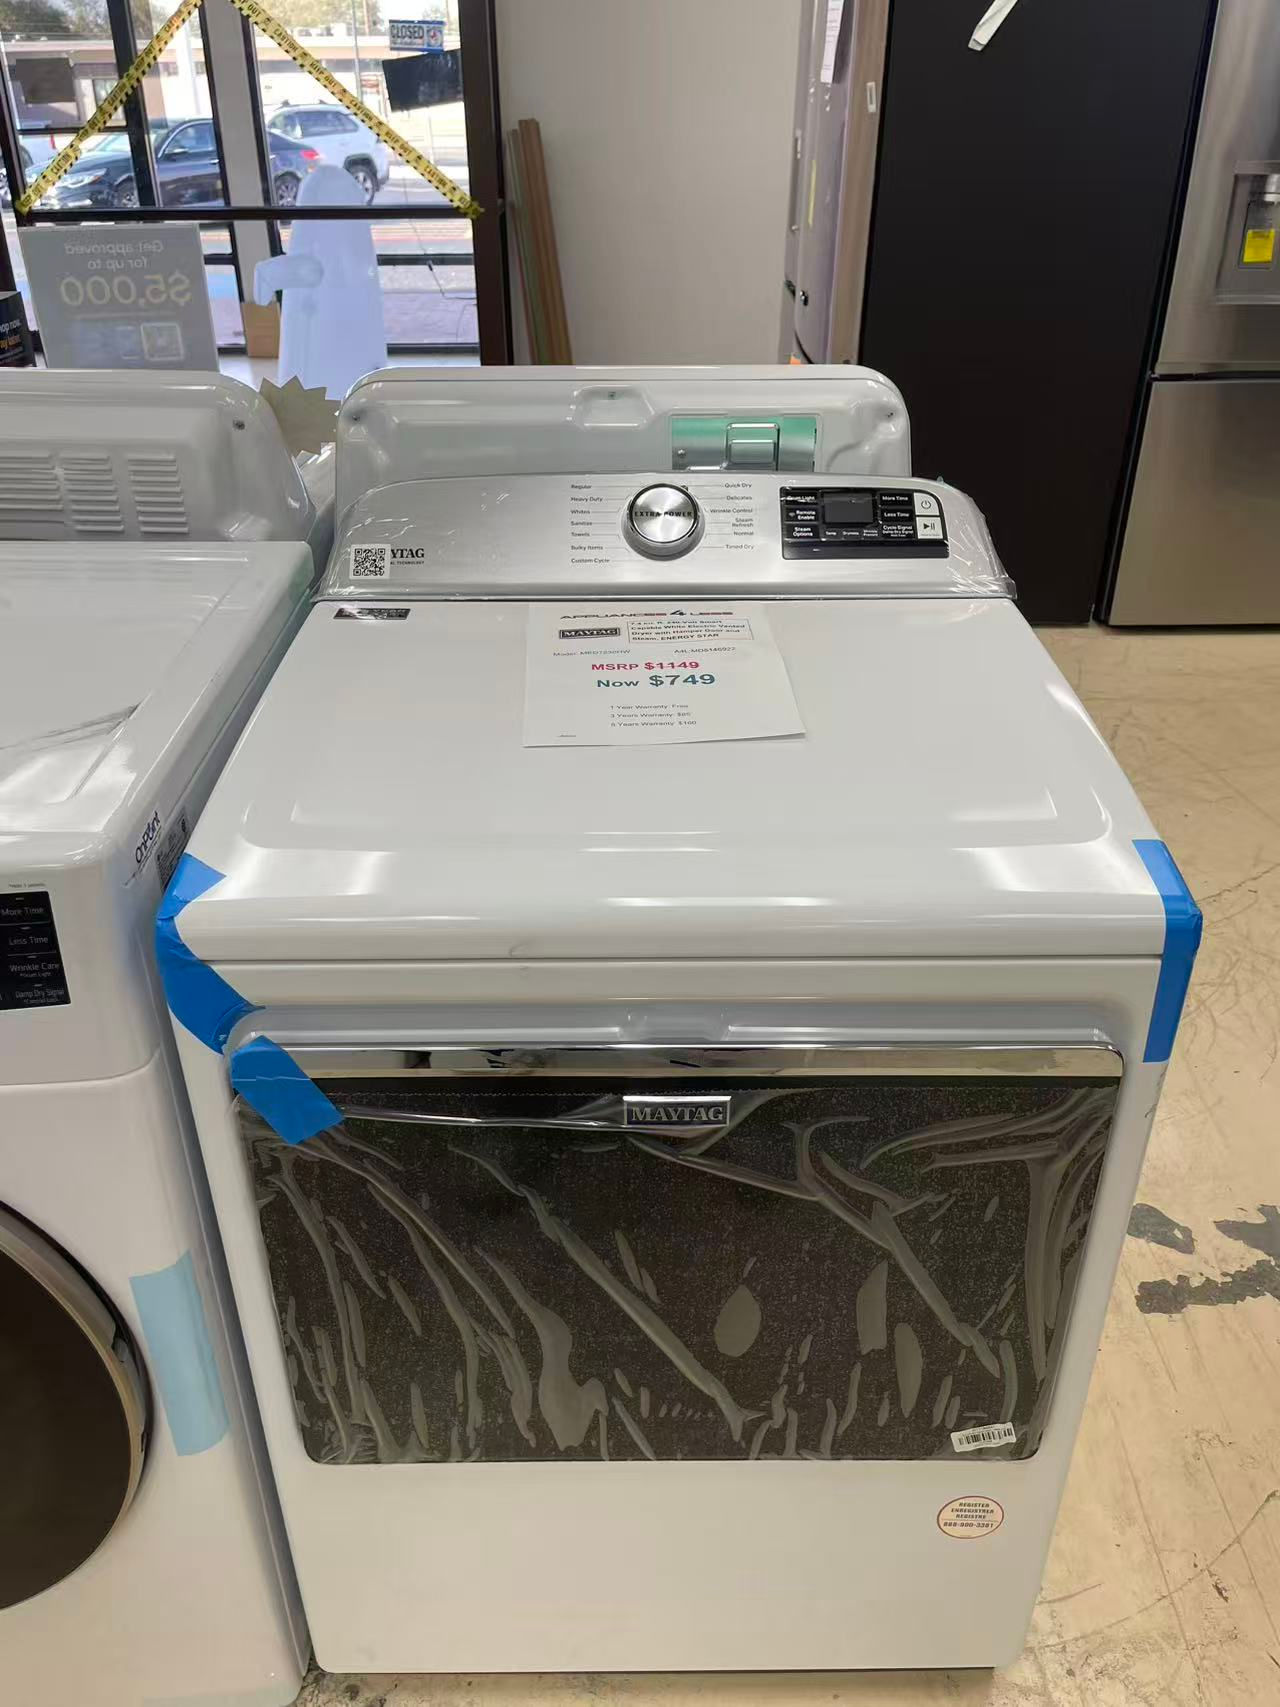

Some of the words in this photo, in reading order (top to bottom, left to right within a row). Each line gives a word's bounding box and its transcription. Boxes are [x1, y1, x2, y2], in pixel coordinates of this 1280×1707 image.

[390, 24, 424, 39] CLOSED
[273, 28, 299, 53] CAUTION
[390, 548, 424, 559] YTAG
[562, 629, 617, 637] MAYTAG
[644, 662, 700, 670] $1149
[648, 674, 716, 688] $749
[136, 810, 161, 864] OnPoint
[24, 906, 44, 914] Time
[8, 936, 28, 946] Less
[28, 936, 48, 944] Time
[9, 964, 40, 972] Wrinkle
[16, 990, 34, 998] Damp
[34, 989, 46, 998] Dry
[632, 1106, 723, 1121] MAYTAG
